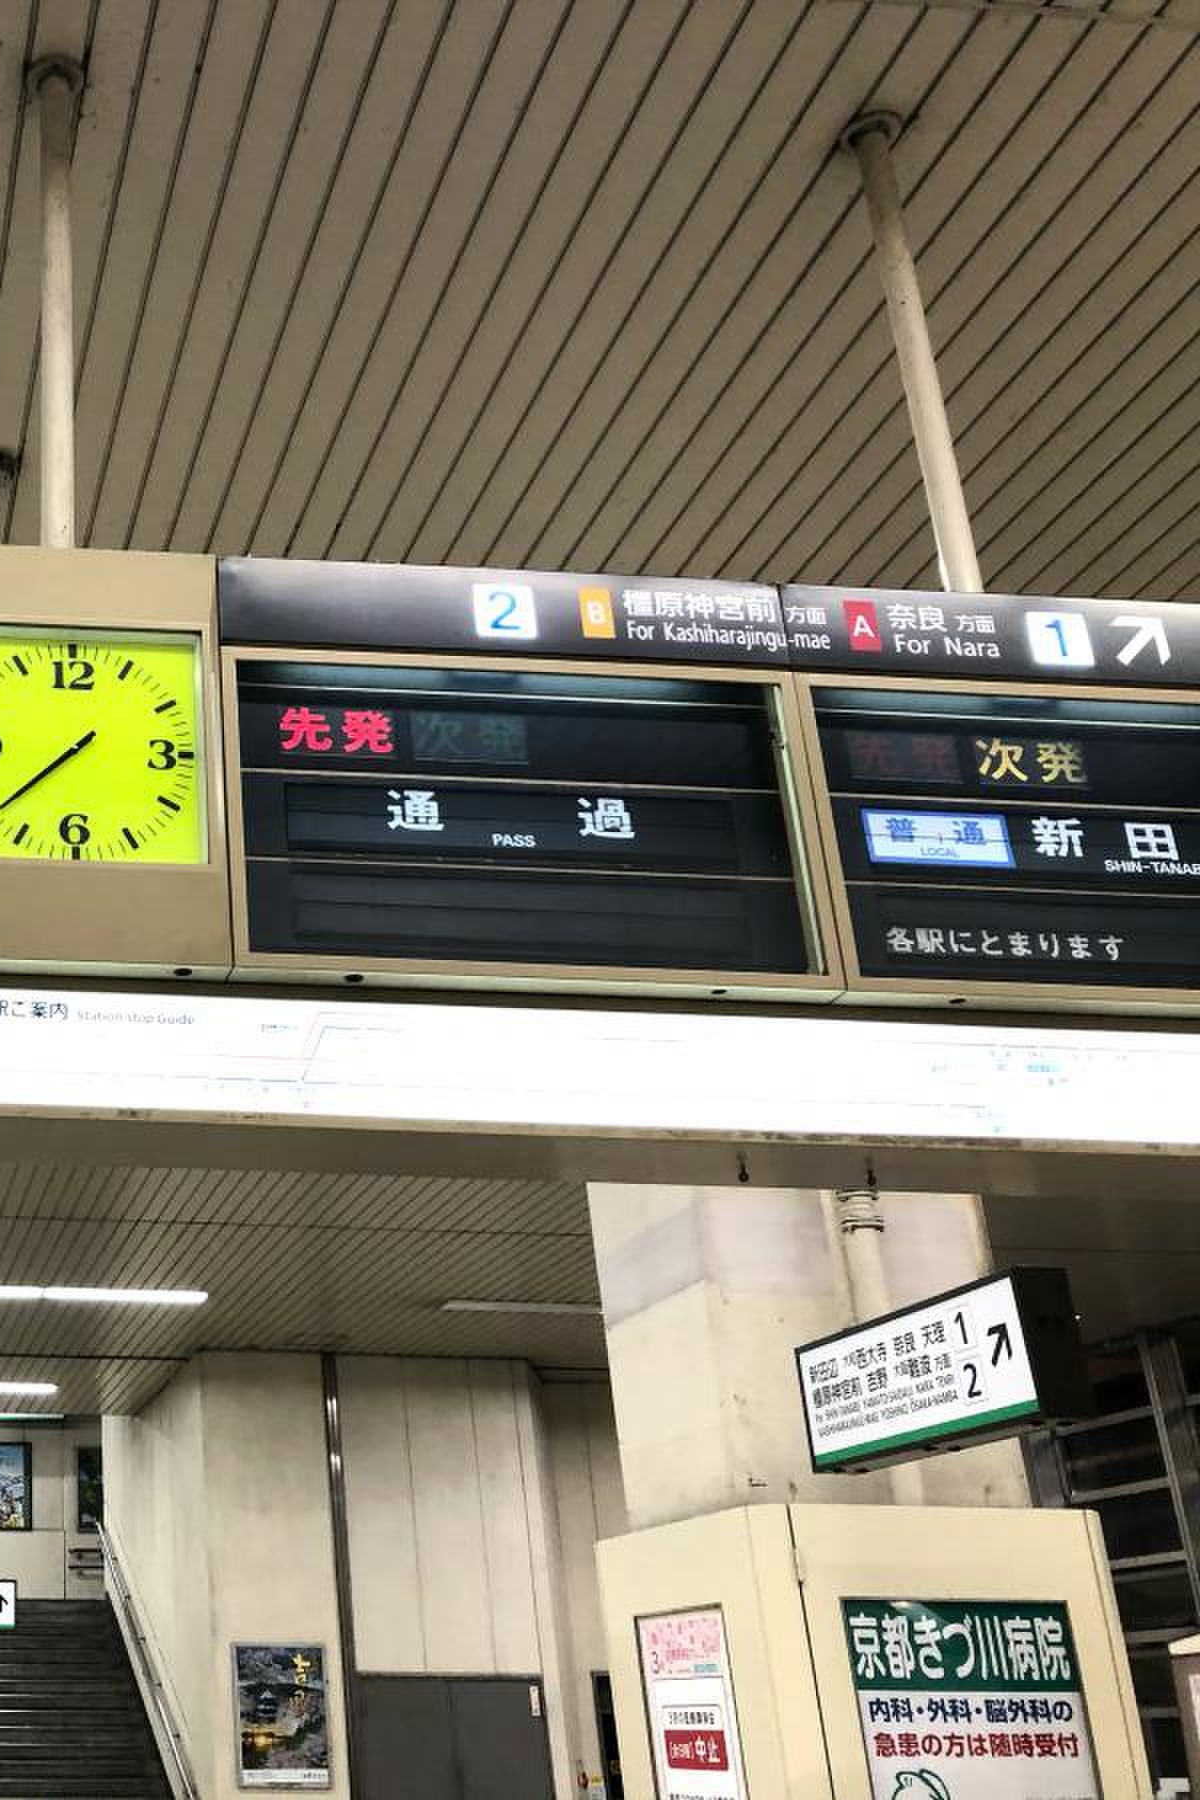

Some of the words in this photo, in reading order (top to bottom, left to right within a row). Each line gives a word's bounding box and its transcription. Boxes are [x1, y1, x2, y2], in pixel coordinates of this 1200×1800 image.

[487, 591, 521, 630] 2
[586, 601, 604, 625] B
[623, 589, 779, 624] 橿原神宮前
[786, 605, 828, 626] 方面
[885, 602, 947, 633] 奈良
[955, 614, 996, 635] 方面
[626, 621, 655, 642] For
[664, 622, 832, 652] Kashiharajingu-mae
[852, 615, 875, 639] A
[1044, 618, 1069, 657] 1
[894, 634, 932, 656] For
[944, 636, 1000, 658] Nara
[51, 660, 95, 691] 12
[279, 706, 395, 754] 先発
[146, 739, 177, 770] 3
[975, 737, 1088, 784] 次発
[58, 813, 91, 846] 6
[491, 832, 536, 849] PASS
[920, 847, 960, 858] LOCAL
[886, 926, 1125, 961] 各駅にとまります
[953, 1311, 969, 1345] 1
[962, 1362, 983, 1399] 2
[849, 1612, 1072, 1681] 京都きづ川病院
[873, 1731, 1080, 1758] 急患の方は随時受付
